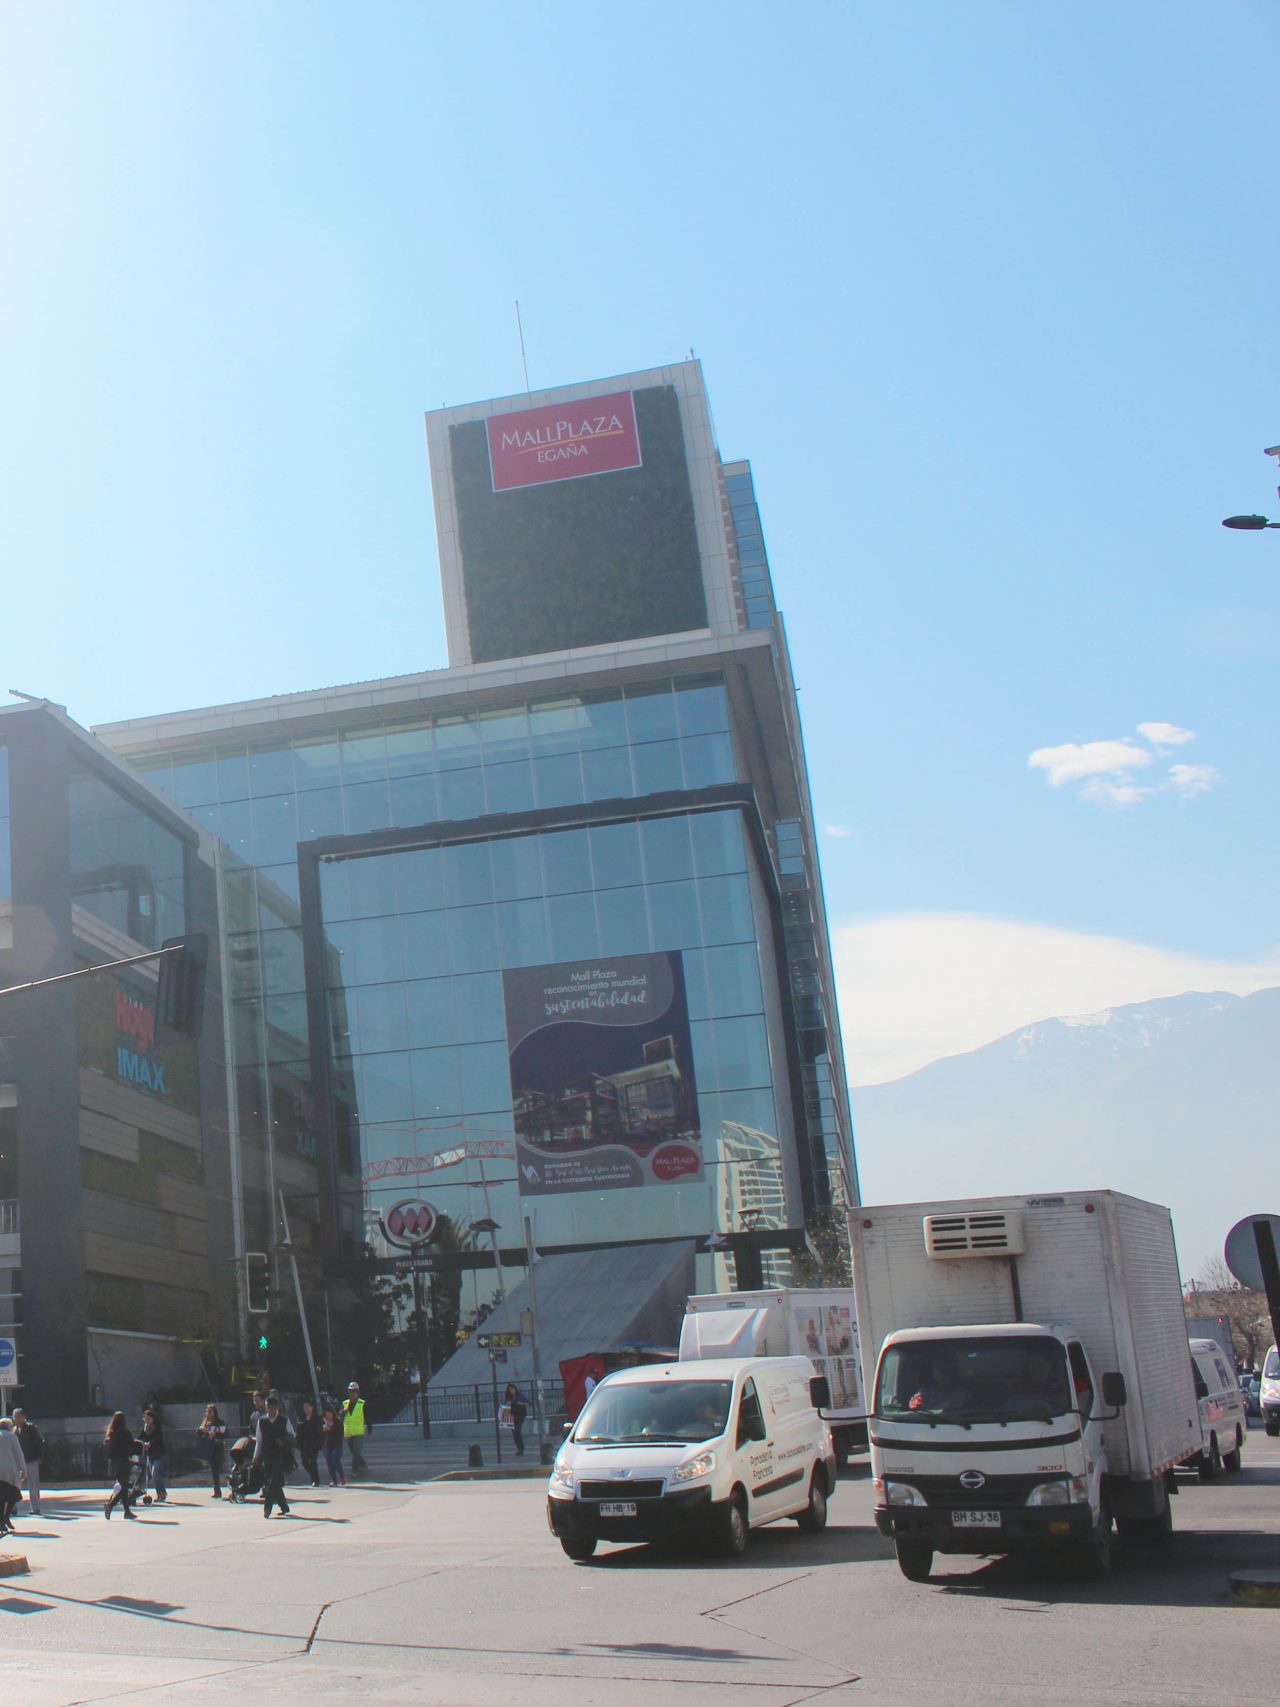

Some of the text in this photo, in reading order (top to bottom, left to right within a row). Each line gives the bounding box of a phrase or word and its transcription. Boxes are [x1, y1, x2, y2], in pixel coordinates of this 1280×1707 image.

[537, 443, 588, 463] EGAÑA
[544, 975, 647, 995] reconocimiento mundial
[571, 968, 617, 982] Mall Plaza
[545, 989, 646, 1015] sustentabilidad
[117, 1047, 167, 1095] IMAX
